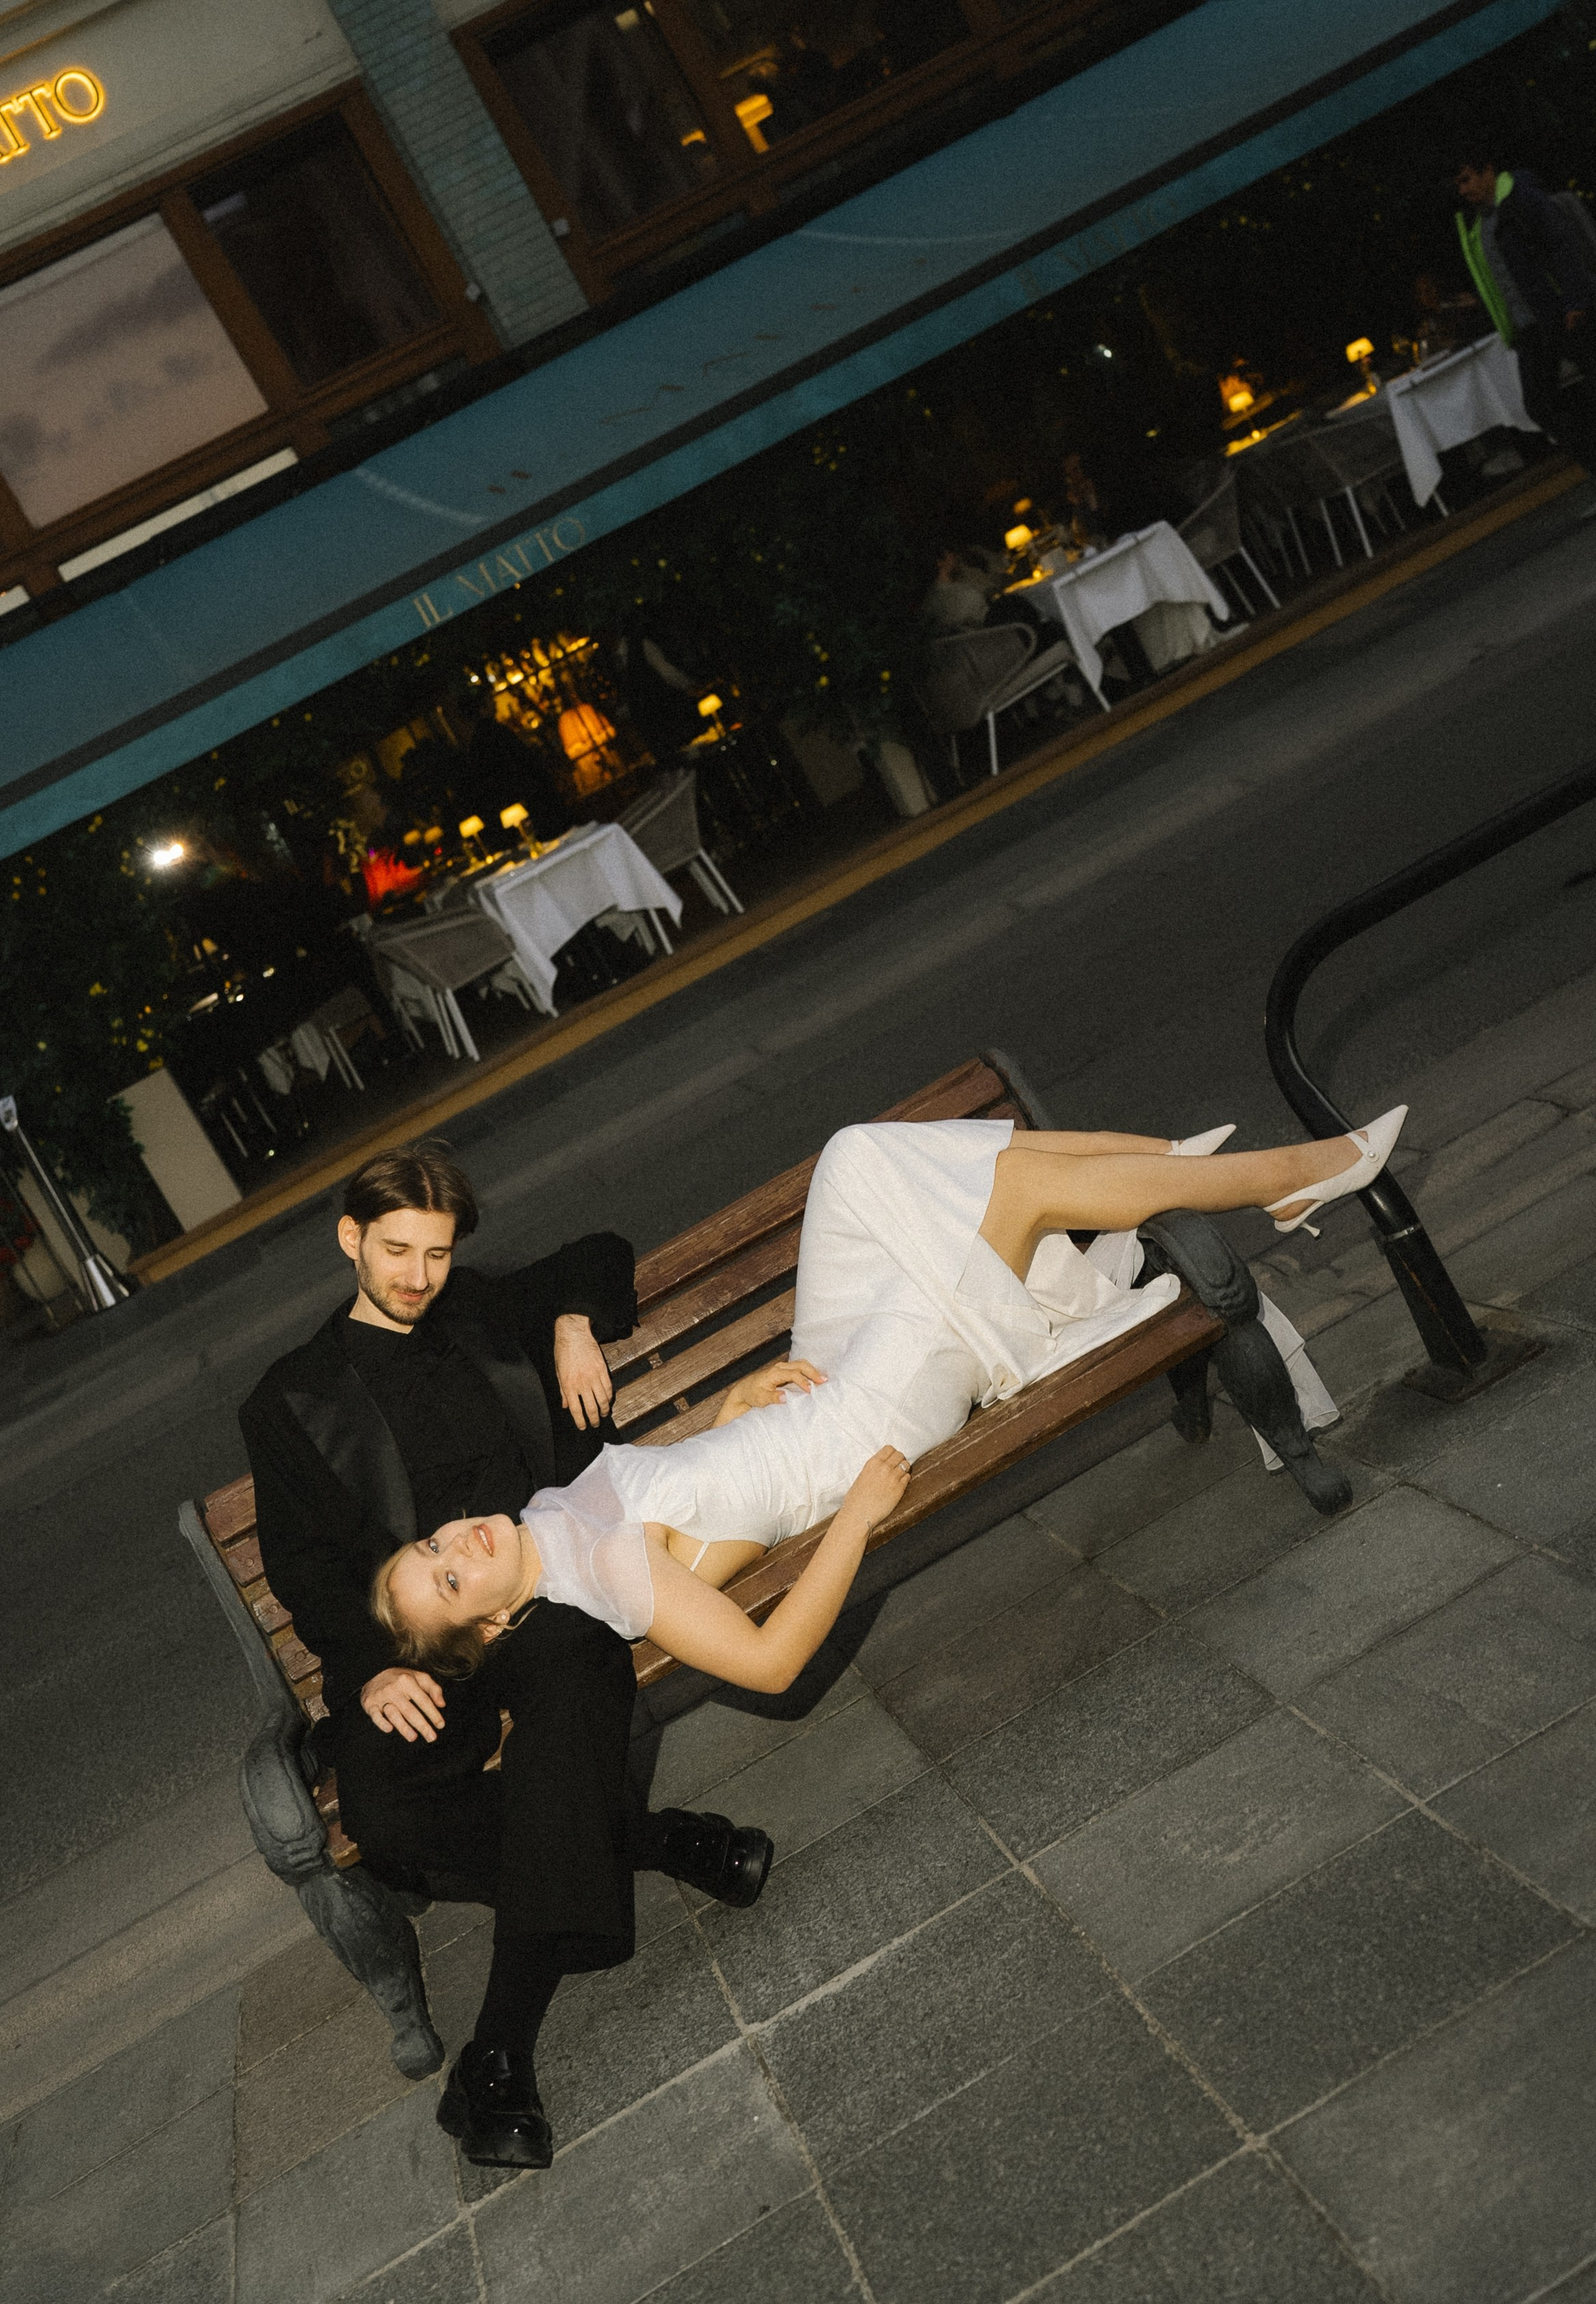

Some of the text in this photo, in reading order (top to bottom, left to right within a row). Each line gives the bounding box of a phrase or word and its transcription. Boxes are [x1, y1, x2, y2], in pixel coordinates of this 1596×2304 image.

[0, 70, 106, 164] TTO
[413, 517, 586, 629] IL MATTO
